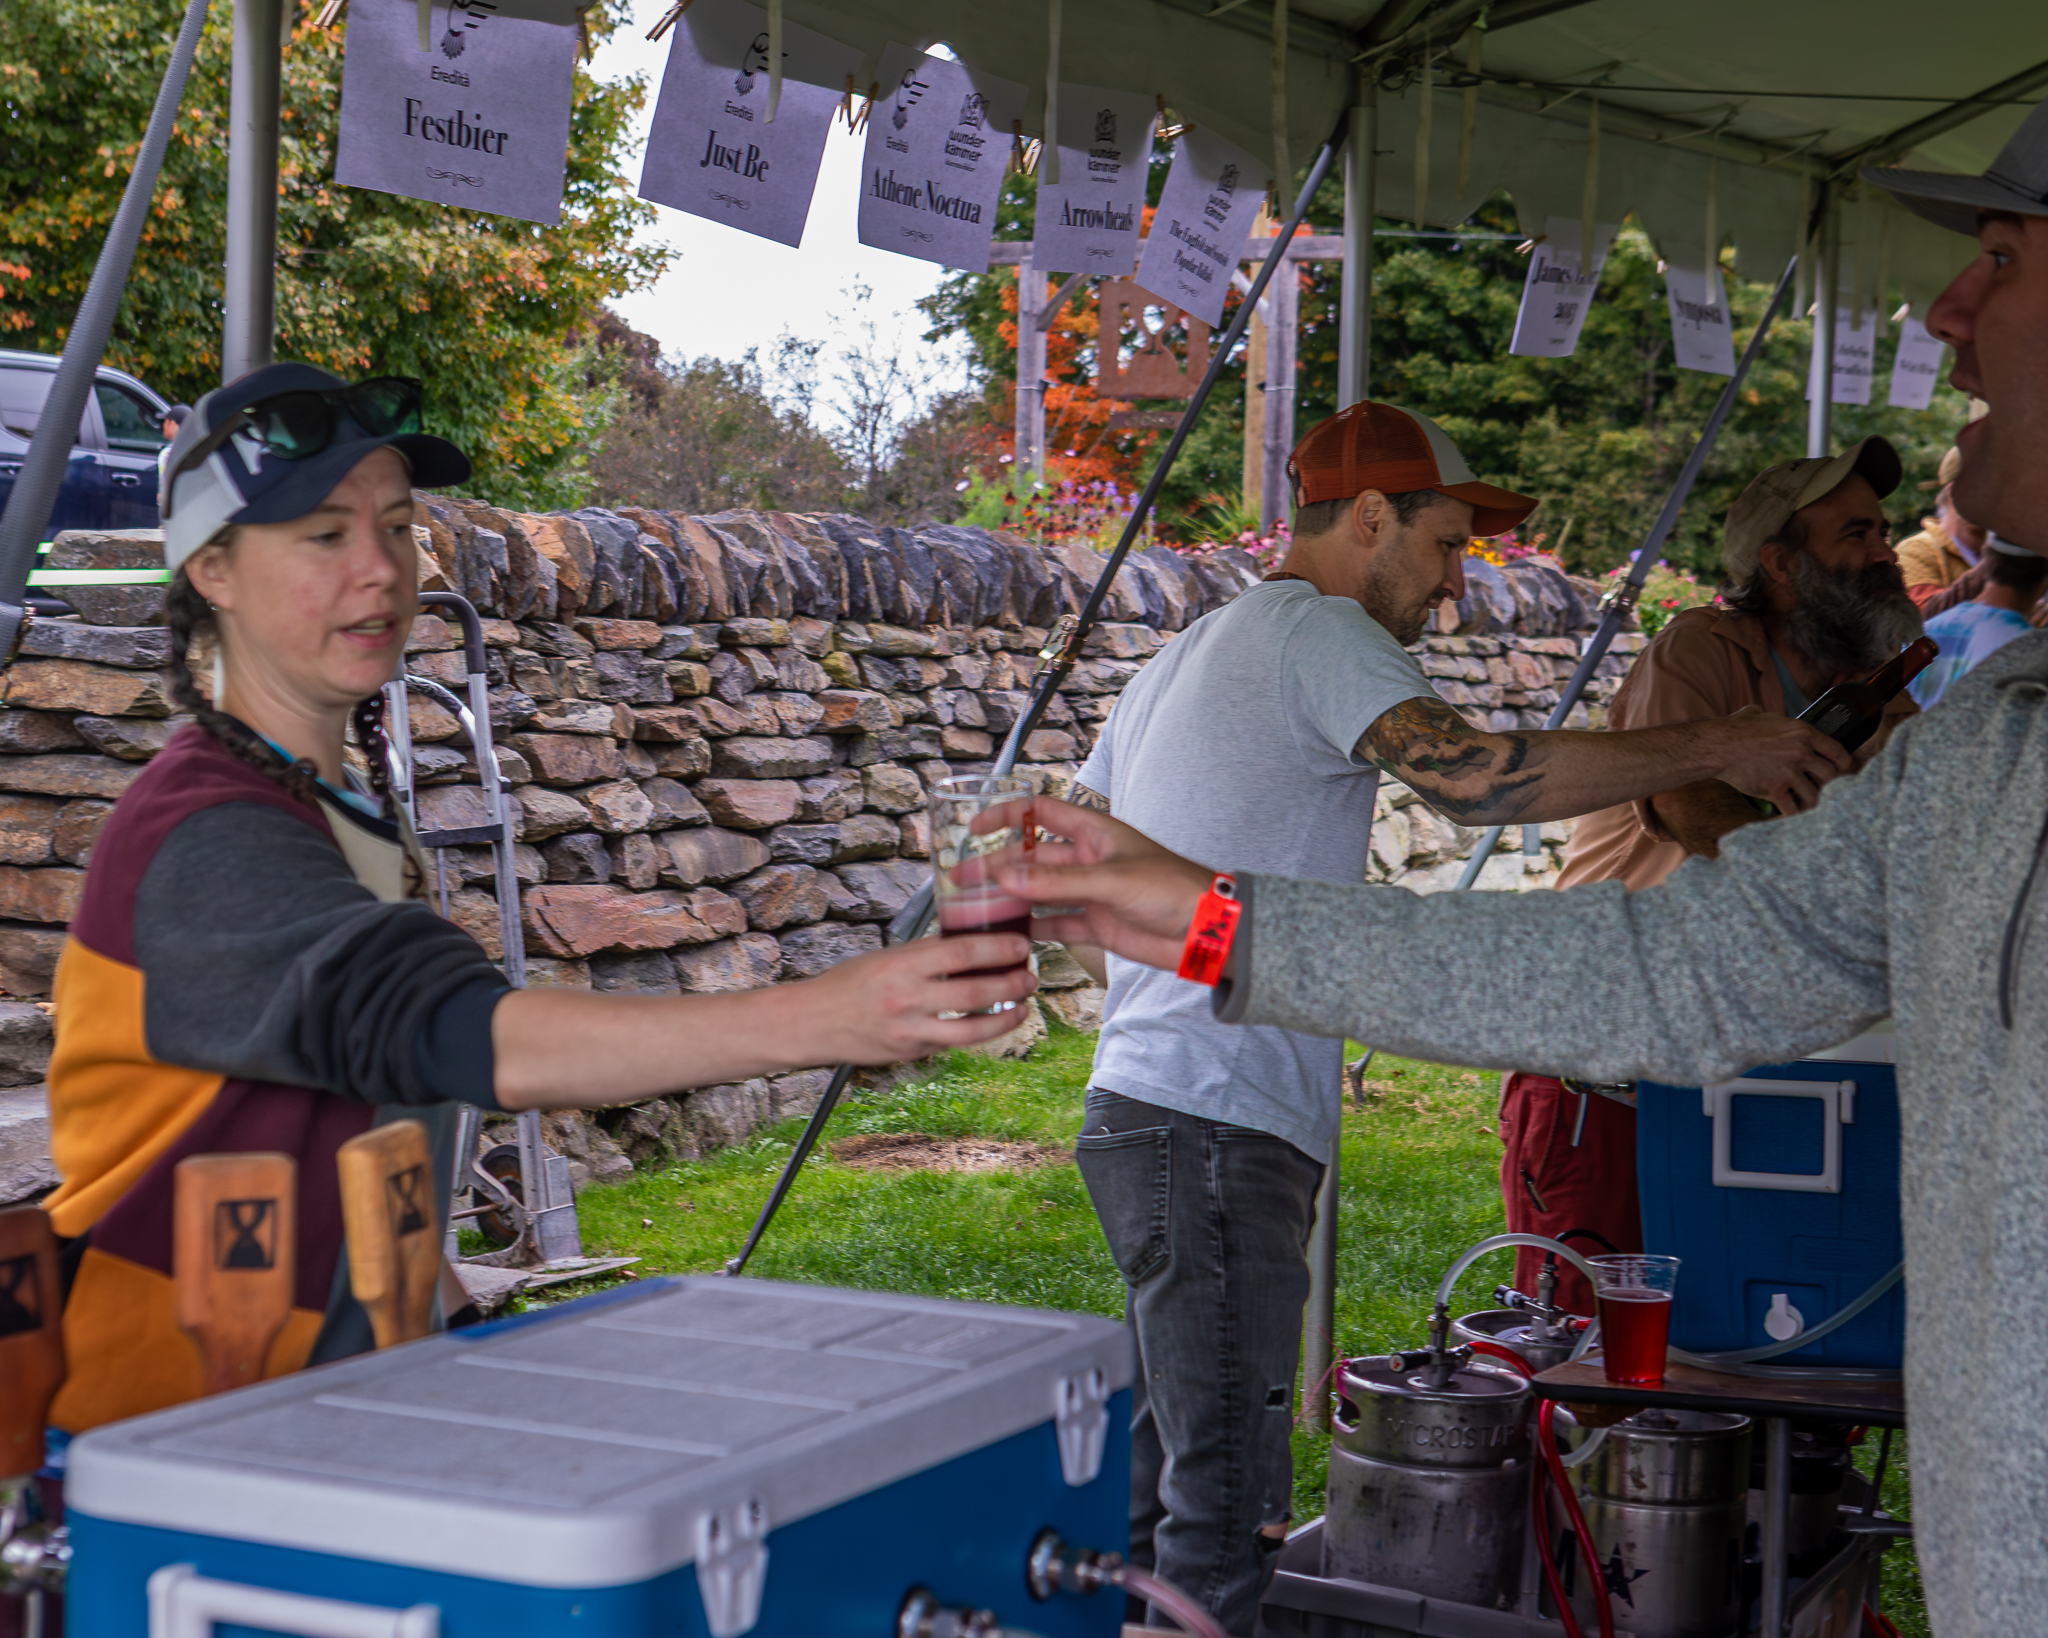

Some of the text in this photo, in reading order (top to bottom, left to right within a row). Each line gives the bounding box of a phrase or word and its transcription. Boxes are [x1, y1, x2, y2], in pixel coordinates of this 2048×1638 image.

[402, 96, 509, 157] Festbier
[949, 130, 987, 149] wunder
[699, 128, 770, 183] Just Be
[868, 166, 982, 225] Athene Noctua
